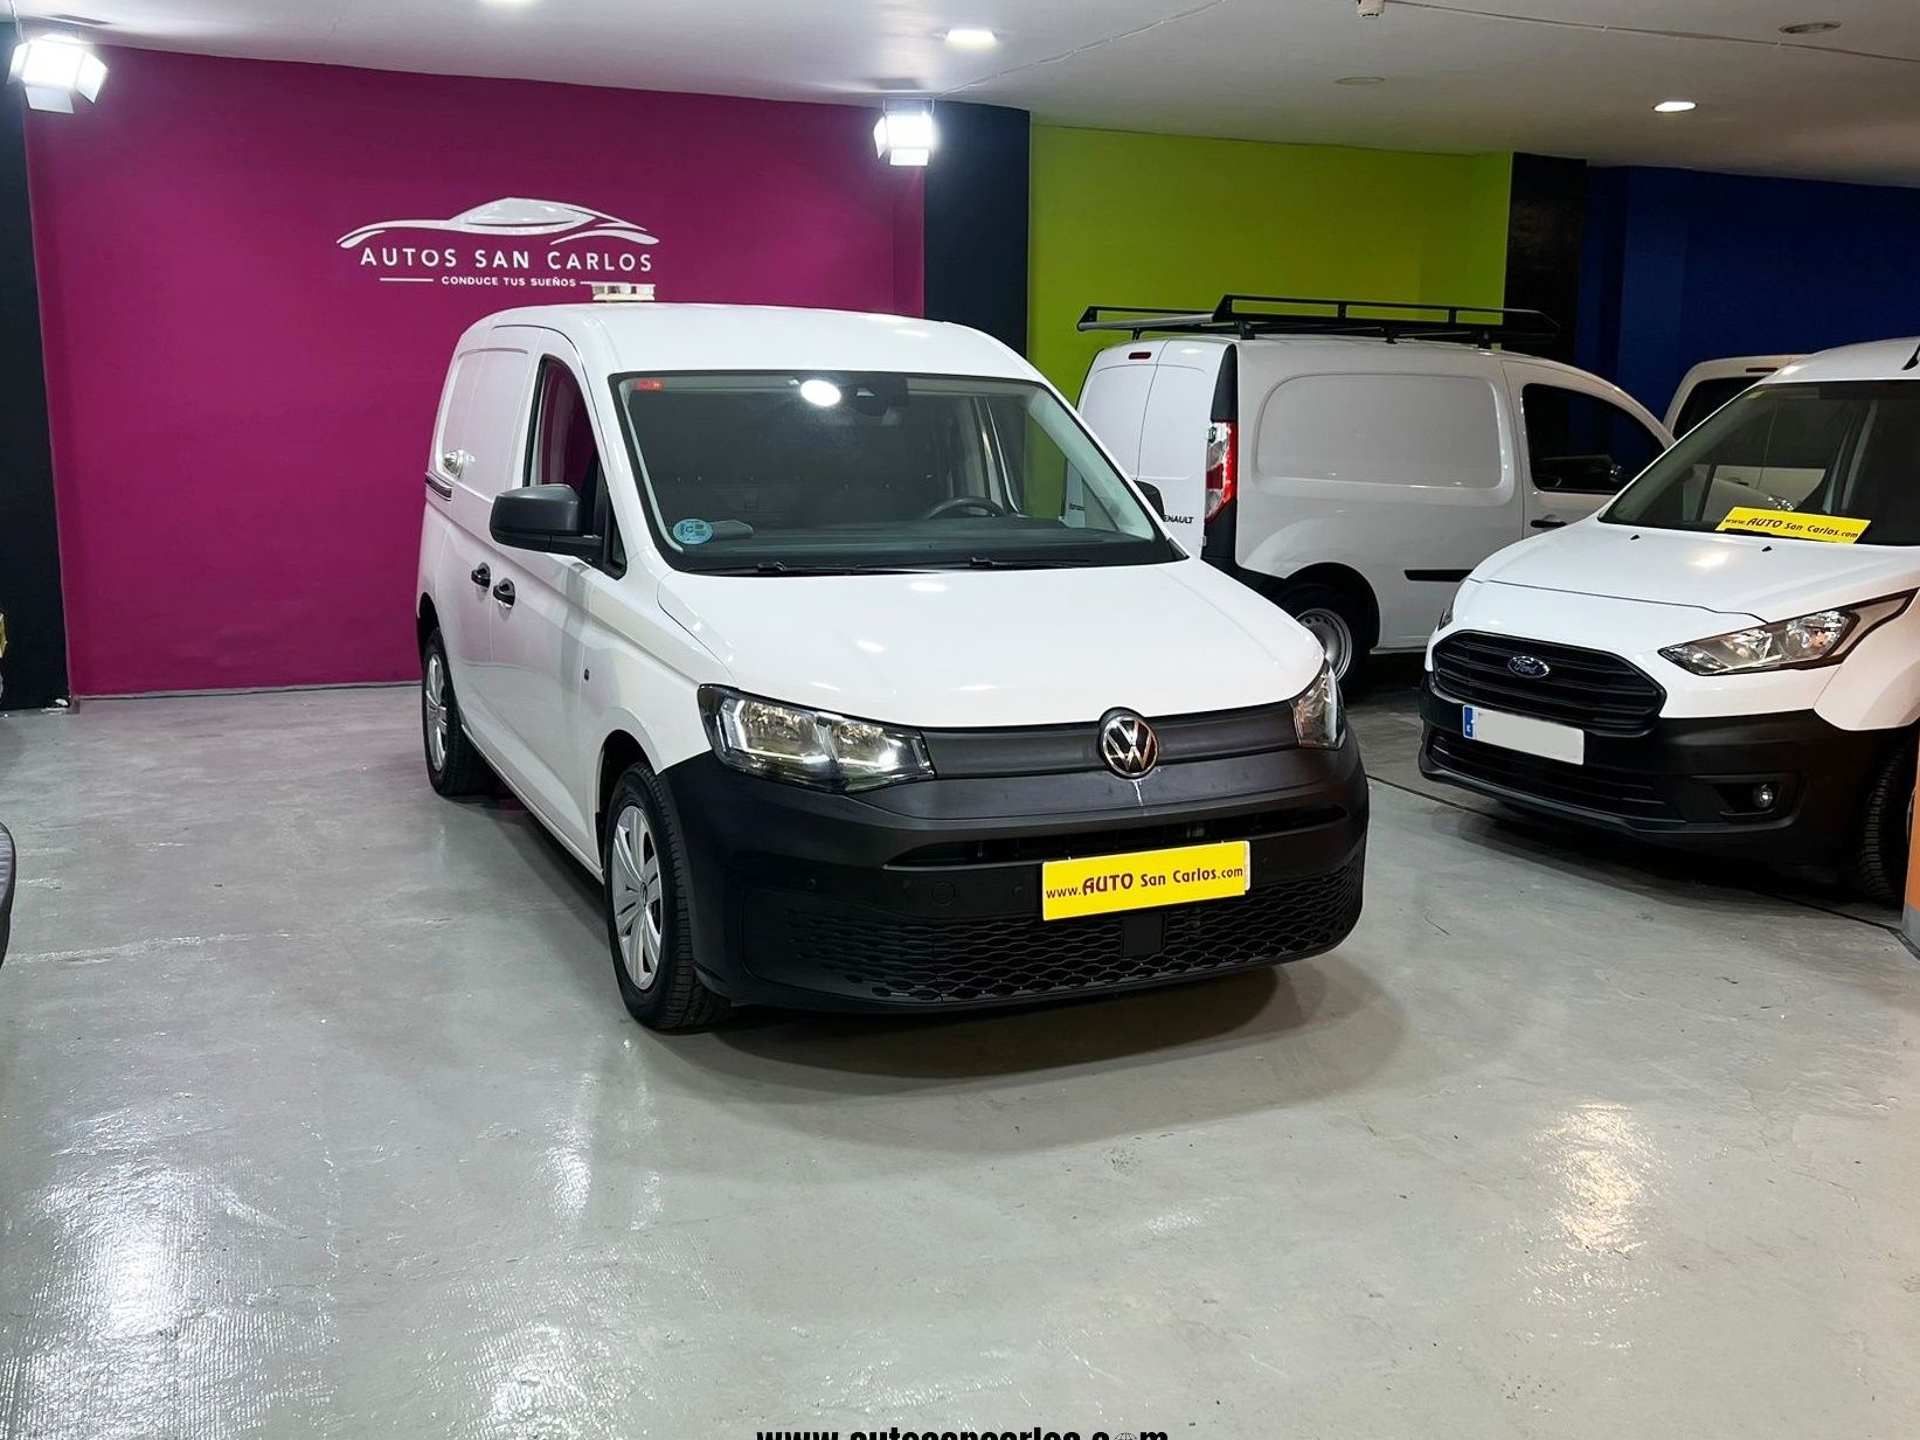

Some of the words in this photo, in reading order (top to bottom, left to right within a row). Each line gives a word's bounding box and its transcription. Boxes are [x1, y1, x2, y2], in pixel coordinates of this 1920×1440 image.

[360, 247, 457, 267] AUTOS
[475, 249, 529, 269] SAN
[547, 251, 652, 272] CARLOS
[441, 275, 499, 286] CONDUCE
[503, 277, 526, 286] TUS
[530, 276, 576, 287] SUEÑOS
[1163, 514, 1194, 524] ENAULT
[1784, 522, 1803, 531] San
[1513, 660, 1538, 674] Ford
[1046, 872, 1134, 899] www.AUTO
[1140, 874, 1166, 888] San
[1173, 867, 1243, 883] Carlos.com
